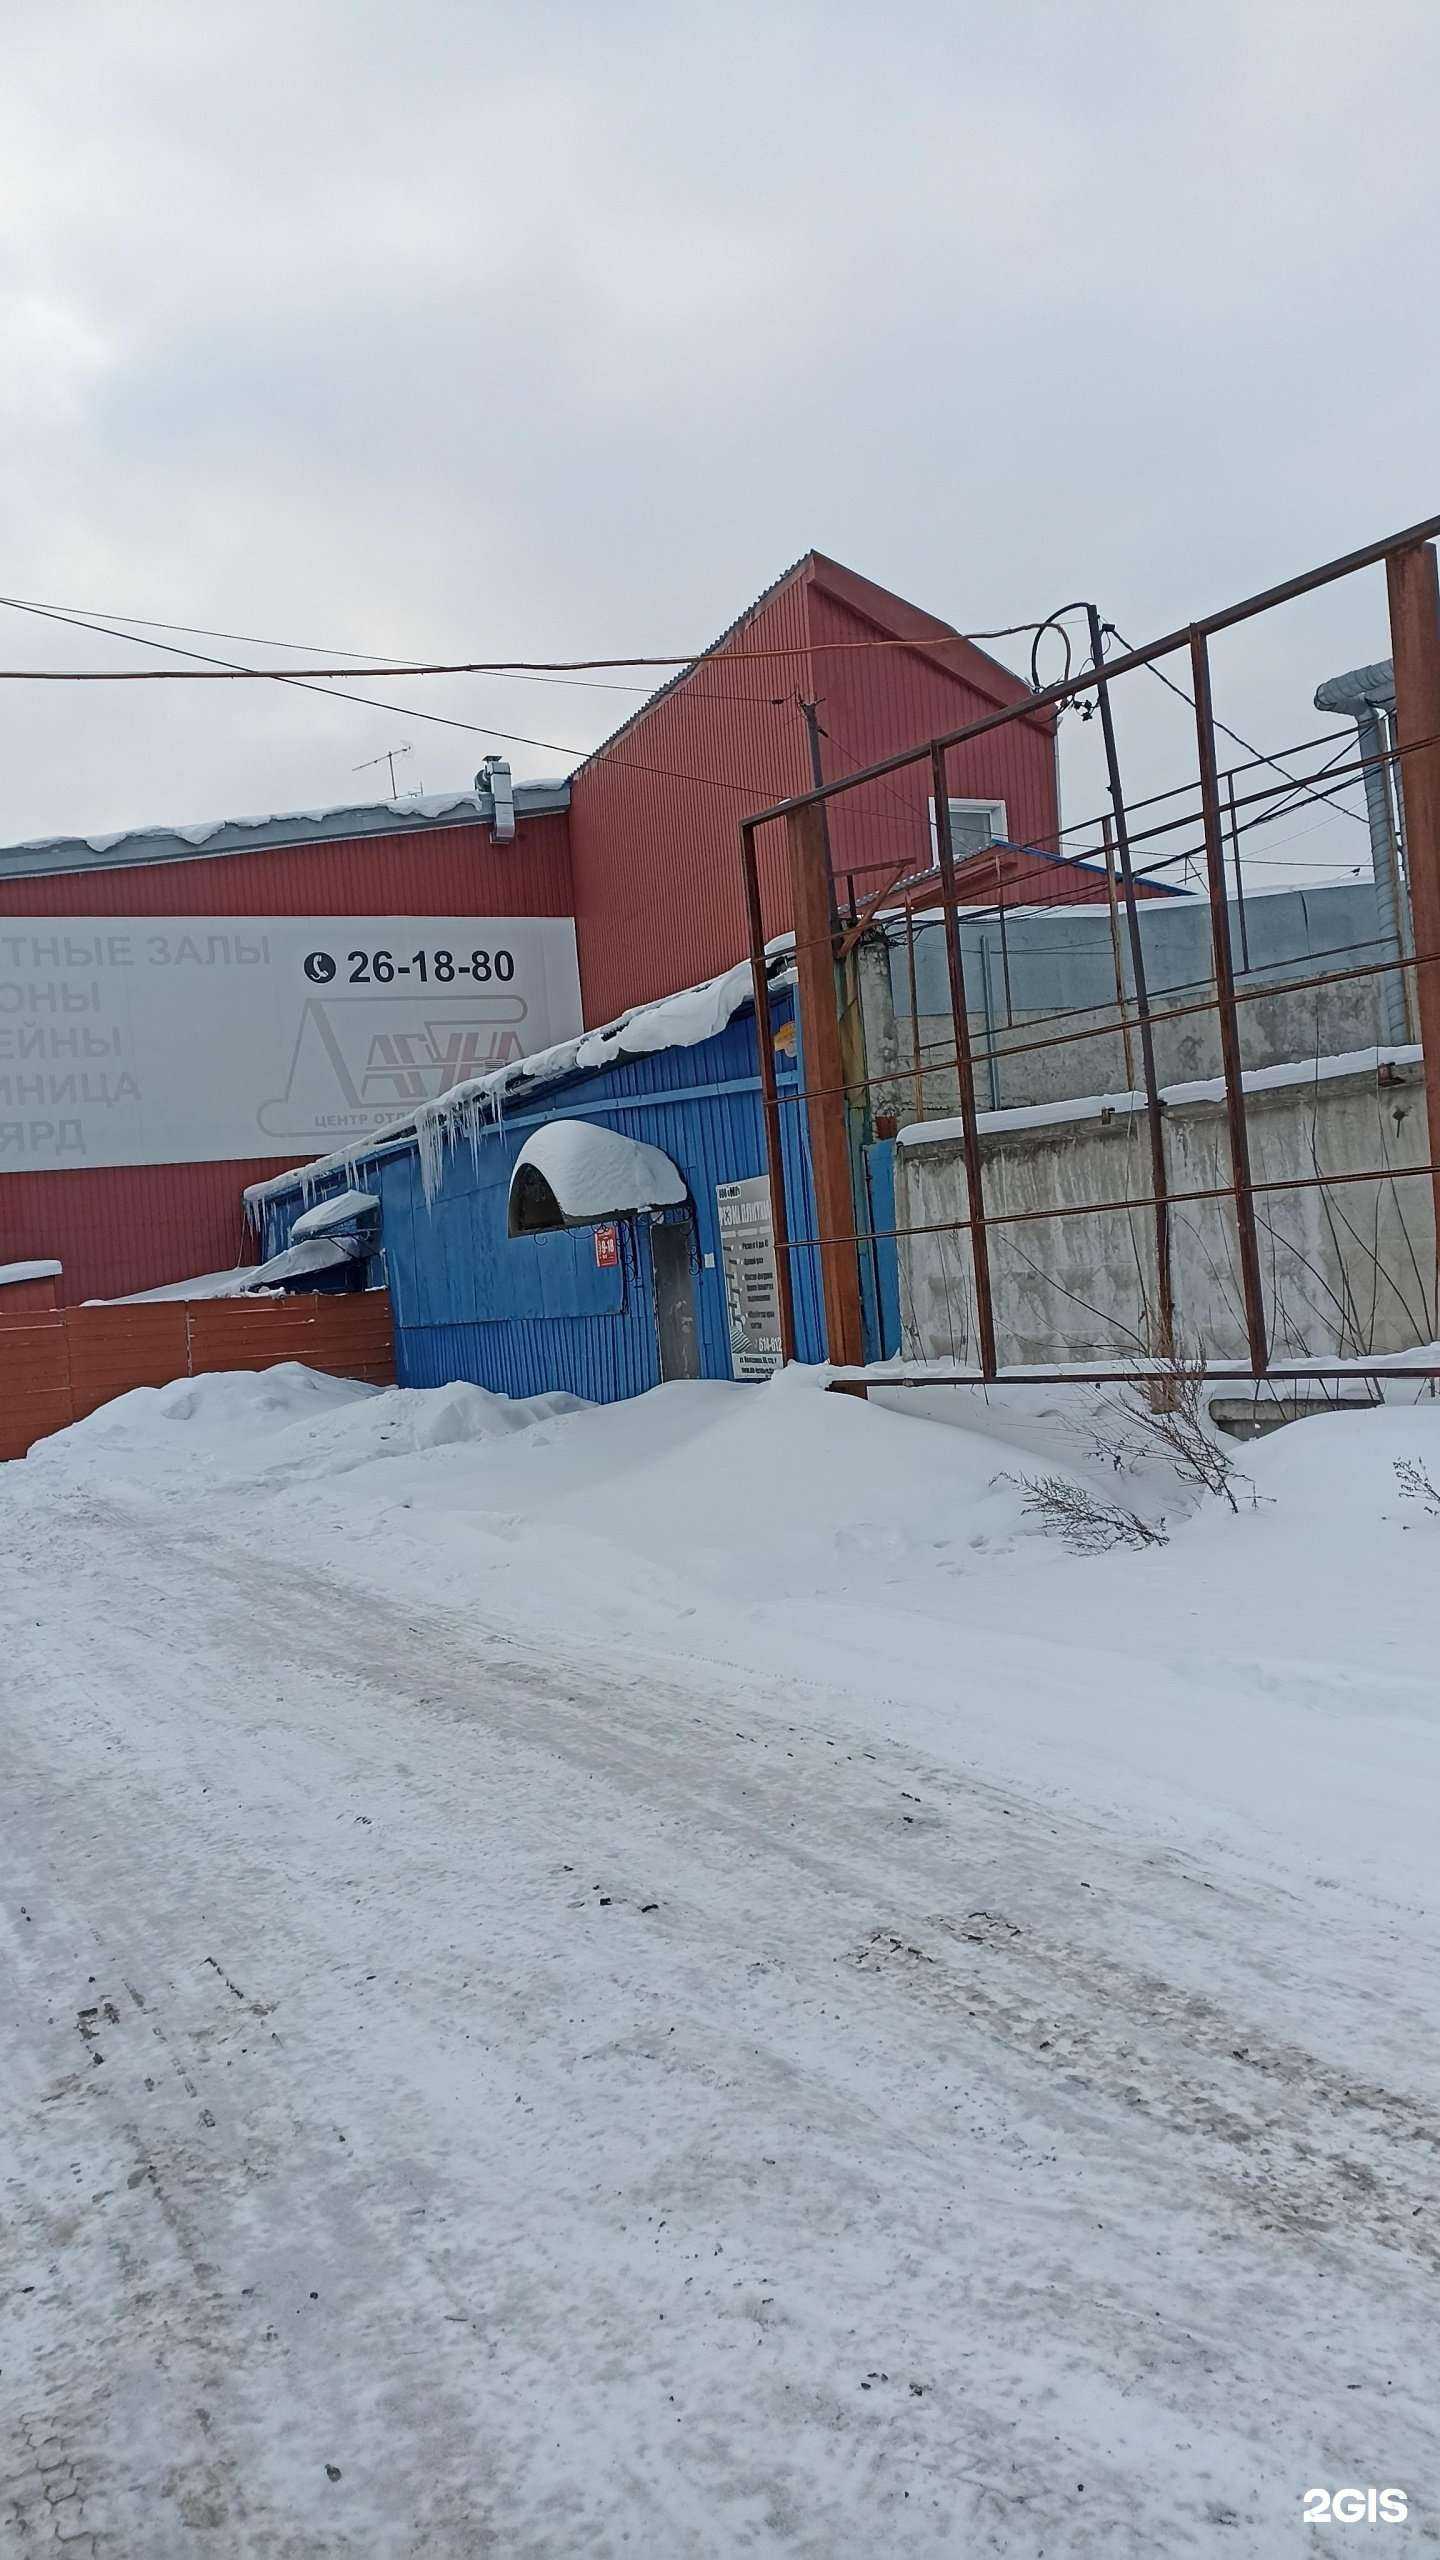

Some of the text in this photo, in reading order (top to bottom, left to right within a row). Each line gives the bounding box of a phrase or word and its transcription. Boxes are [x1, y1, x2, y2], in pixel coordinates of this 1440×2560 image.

[146, 935, 271, 966] ЗАЛЫ
[347, 950, 515, 983] 26-18-80
[314, 1112, 368, 1128] ЦЕНТР
